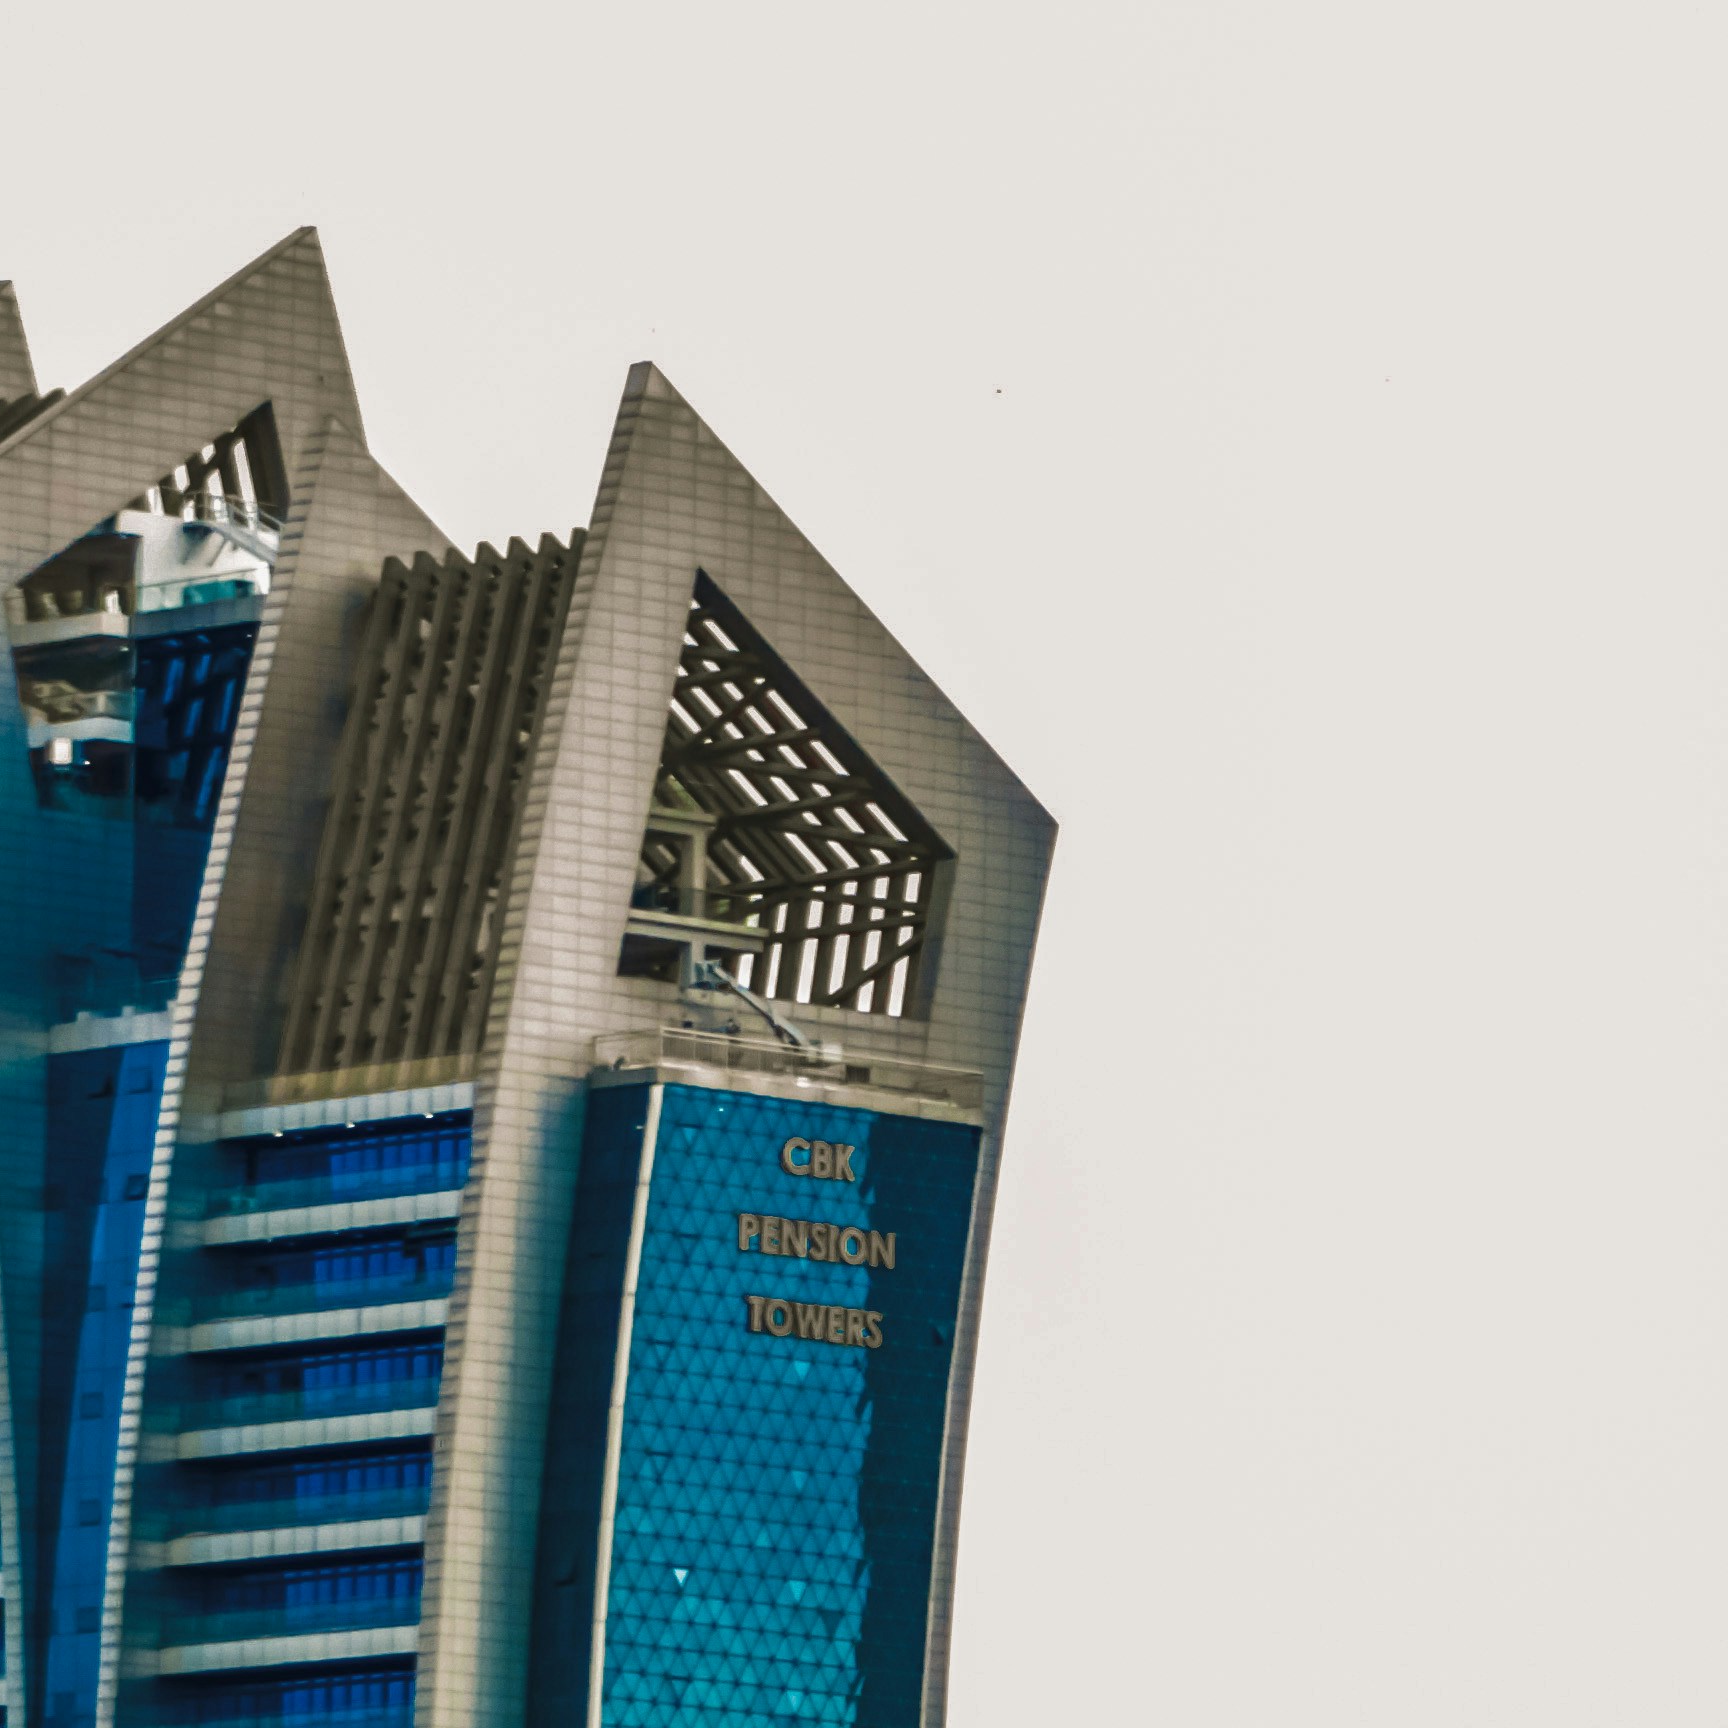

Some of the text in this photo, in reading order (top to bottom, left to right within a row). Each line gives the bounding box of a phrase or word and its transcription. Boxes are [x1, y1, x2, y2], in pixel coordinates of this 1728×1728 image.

[782, 1137, 855, 1181] CBK
[739, 1213, 896, 1269] PENSION
[746, 1295, 883, 1348] TOWERS
